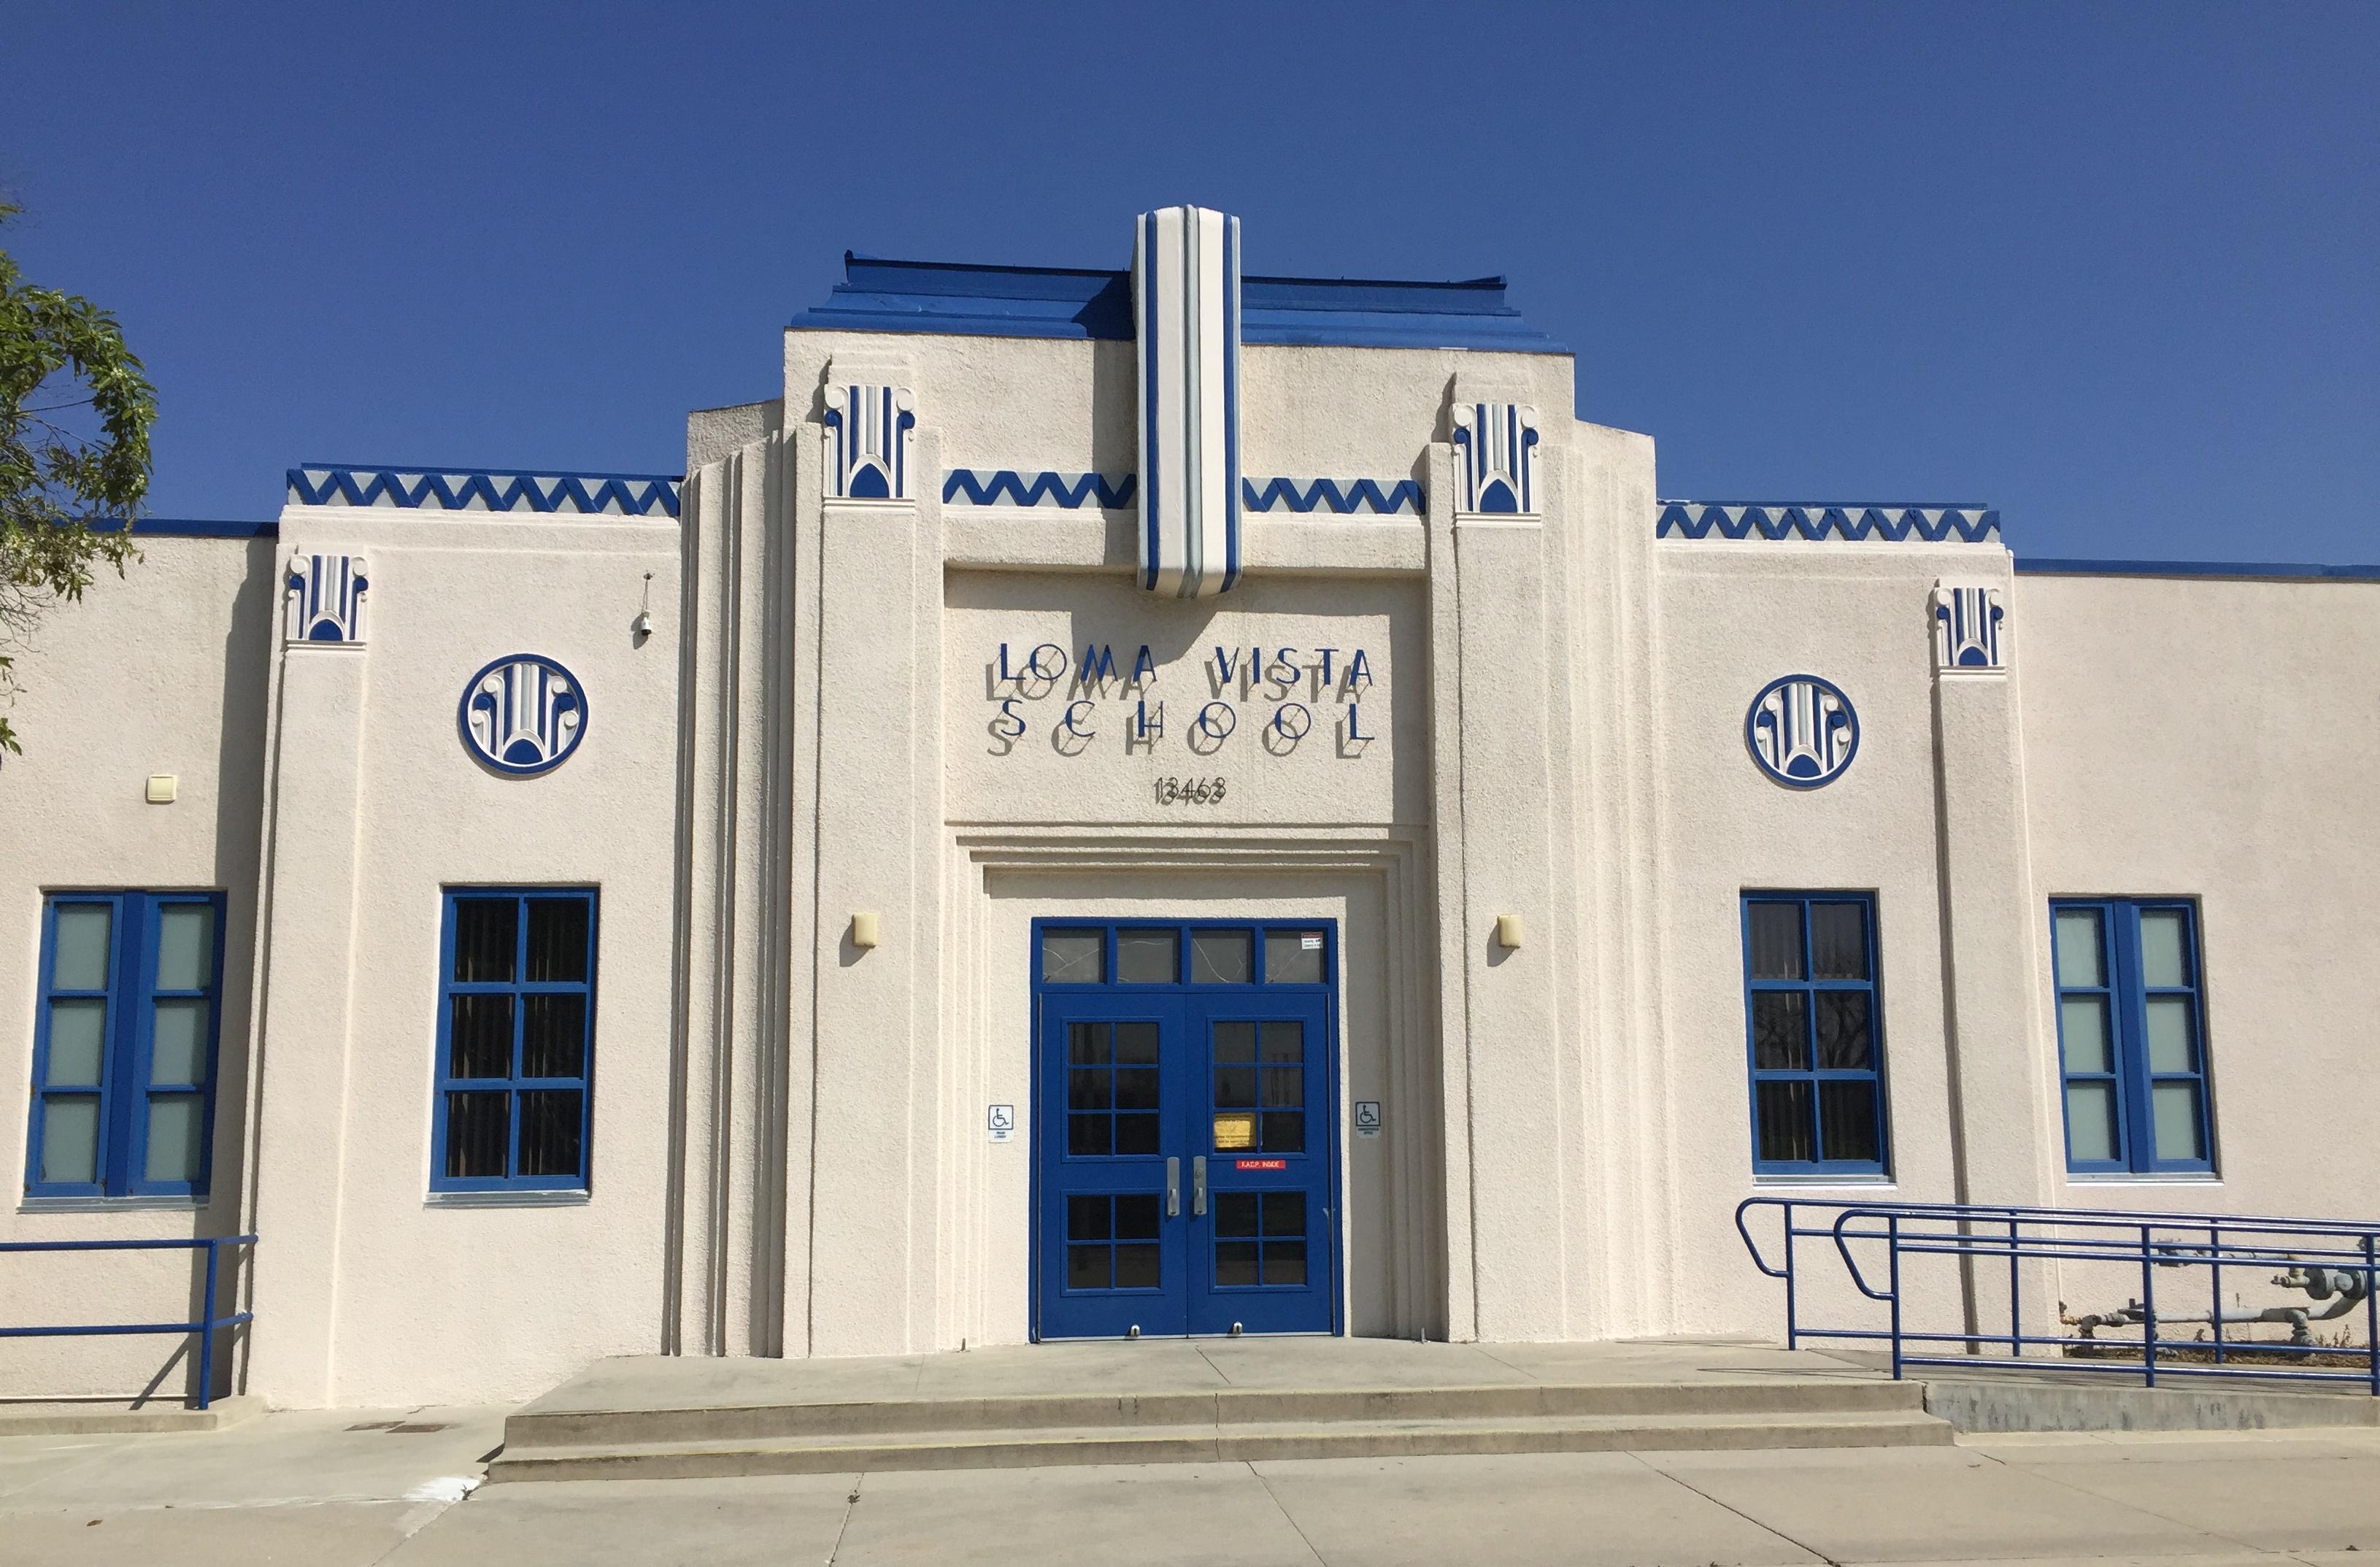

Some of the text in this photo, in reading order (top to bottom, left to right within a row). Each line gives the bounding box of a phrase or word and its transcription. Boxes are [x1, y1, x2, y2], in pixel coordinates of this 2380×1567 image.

[1001, 643, 1374, 687] LOMA VISTA
[1001, 698, 1375, 740] SCHOOL
[1158, 777, 1226, 799] 13463
